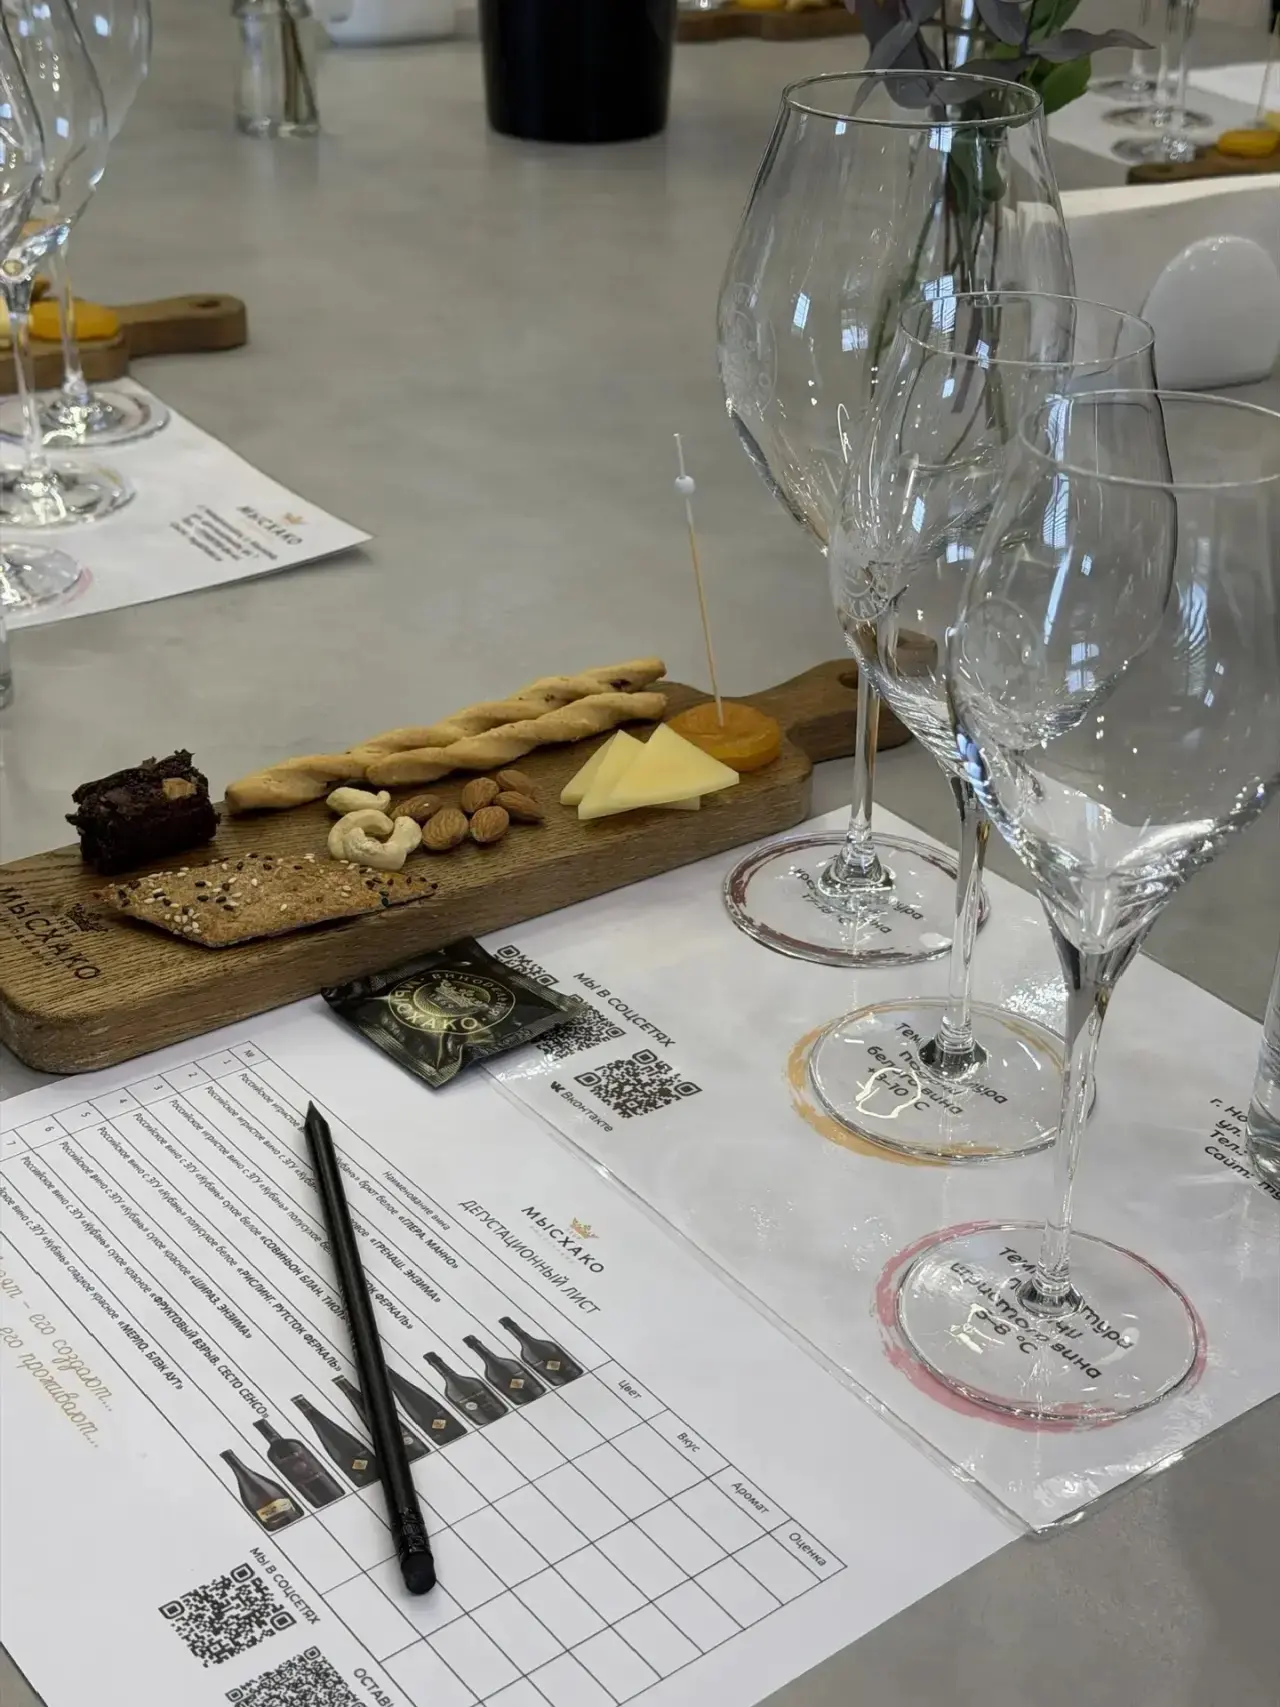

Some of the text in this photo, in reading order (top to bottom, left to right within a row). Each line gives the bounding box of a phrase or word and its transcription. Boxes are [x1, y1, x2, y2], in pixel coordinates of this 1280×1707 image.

[573, 972, 676, 1048] МЫ В СОЦСЕТЯХ
[921, 1087, 964, 1116] вина
[1215, 1119, 1241, 1137] ул.
[204, 1085, 240, 1117] Российское
[236, 1116, 266, 1141] игристое
[262, 1140, 281, 1155] вино
[281, 1157, 299, 1169] ЗГУ
[369, 1238, 406, 1271] «ГРЕНАШ.
[403, 1268, 441, 1303] ЭНЗИМА»
[238, 1072, 274, 1104] Российское
[271, 1103, 301, 1128] игристое
[358, 1180, 380, 1197] брют
[375, 1195, 399, 1215] белое
[424, 1238, 459, 1269] МАННО»
[382, 1170, 451, 1231] Наименование вина
[1204, 1146, 1255, 1179] Сайт:
[58, 1141, 94, 1175] Российское
[89, 1173, 109, 1190] вино
[108, 1191, 126, 1204] ЗГУ
[120, 1204, 150, 1232] «Кубань»
[146, 1231, 167, 1250] сухое
[162, 1249, 192, 1276] красное
[188, 1275, 221, 1306] «ШИРАЗ.
[216, 1303, 252, 1339] ЭНЗИМА»
[132, 1112, 168, 1145] Российское
[164, 1144, 183, 1160] вино
[183, 1161, 200, 1174] ЗГУ
[195, 1173, 225, 1201] «Кубань»
[222, 1200, 243, 1218] сухое
[239, 1216, 262, 1237] белое
[259, 1235, 304, 1276] «СОВИНЬОН
[299, 1274, 324, 1298] БЛАН.
[168, 1099, 204, 1131] Российское
[201, 1130, 230, 1156] игристое
[226, 1154, 245, 1170] вино
[245, 1172, 264, 1184] ЗГУ
[258, 1183, 289, 1212] «Кубань»
[286, 1211, 321, 1243] полусухое
[374, 1293, 413, 1330] ФЕРКАЛЬ»
[521, 1206, 605, 1273] МЫСХАКО
[20, 1155, 56, 1190] Российское
[51, 1189, 70, 1205] вино
[69, 1207, 86, 1220] ЗГУ
[80, 1219, 111, 1249] «Кубань»
[107, 1248, 128, 1267] сухое
[124, 1266, 153, 1294] красное
[149, 1292, 200, 1340] «ФРУКТОВЫЙ
[191, 1338, 220, 1366] ВЗРЫВ.
[217, 1364, 244, 1389] СЕСТО
[238, 1389, 270, 1419] СЕНСО»
[97, 1126, 131, 1160] Российское
[127, 1159, 146, 1175] вино
[145, 1176, 164, 1188] ЗГУ
[157, 1188, 187, 1216] «Кубань»
[183, 1215, 219, 1247] полусухое
[215, 1245, 238, 1267] белое
[236, 1267, 277, 1305] «РИСЛИНГ.
[271, 1302, 307, 1335] РУТСТОК
[303, 1333, 342, 1372] ФЕРКАЛЬ»
[458, 1200, 570, 1288] ДЕГУСТАЦИОННЫЙ
[560, 1286, 601, 1314] ЛИСТ
[11, 1204, 30, 1222] вино
[28, 1223, 48, 1236] ЗГУ
[41, 1236, 70, 1266] «Кубань»
[66, 1265, 96, 1293] сладкое
[90, 1291, 120, 1320] красное
[117, 1320, 149, 1353] «МЕРЛО.
[144, 1350, 169, 1373] БЛЭК
[162, 1371, 184, 1390] АУТ»
[29, 1313, 56, 1335] его
[51, 1339, 113, 1412] создают...
[617, 1379, 642, 1400] Цвет
[1050, 1342, 1102, 1379] вина
[16, 1352, 99, 1448] проживают...
[676, 1431, 701, 1454] Вкус
[730, 1480, 770, 1515] Аромат
[250, 1547, 322, 1625] МЫ В СОЦСЕТЯХ
[788, 1532, 827, 1567] Оценка
